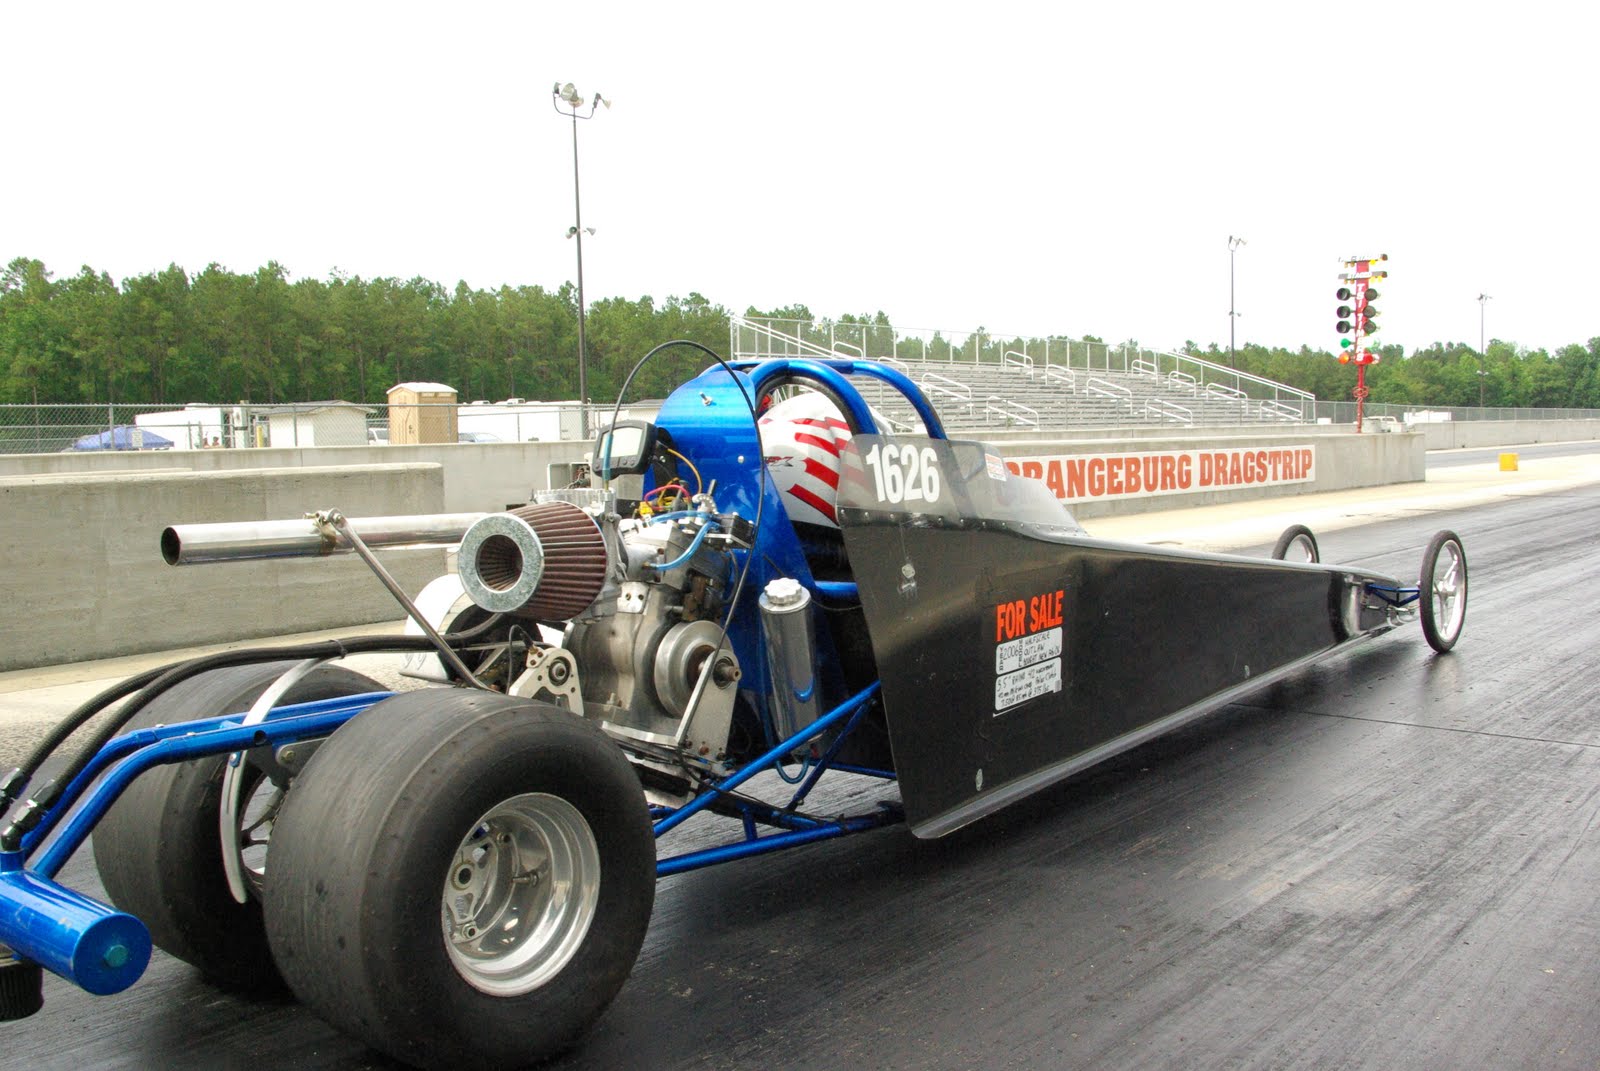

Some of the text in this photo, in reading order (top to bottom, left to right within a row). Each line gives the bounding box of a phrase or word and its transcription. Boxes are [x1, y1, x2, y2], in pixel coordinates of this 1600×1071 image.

[865, 444, 940, 504] 1626
[1199, 448, 1313, 486] DRAGSTRIP
[997, 590, 1064, 641] FOR SALE
[1003, 644, 1019, 660] 2006
